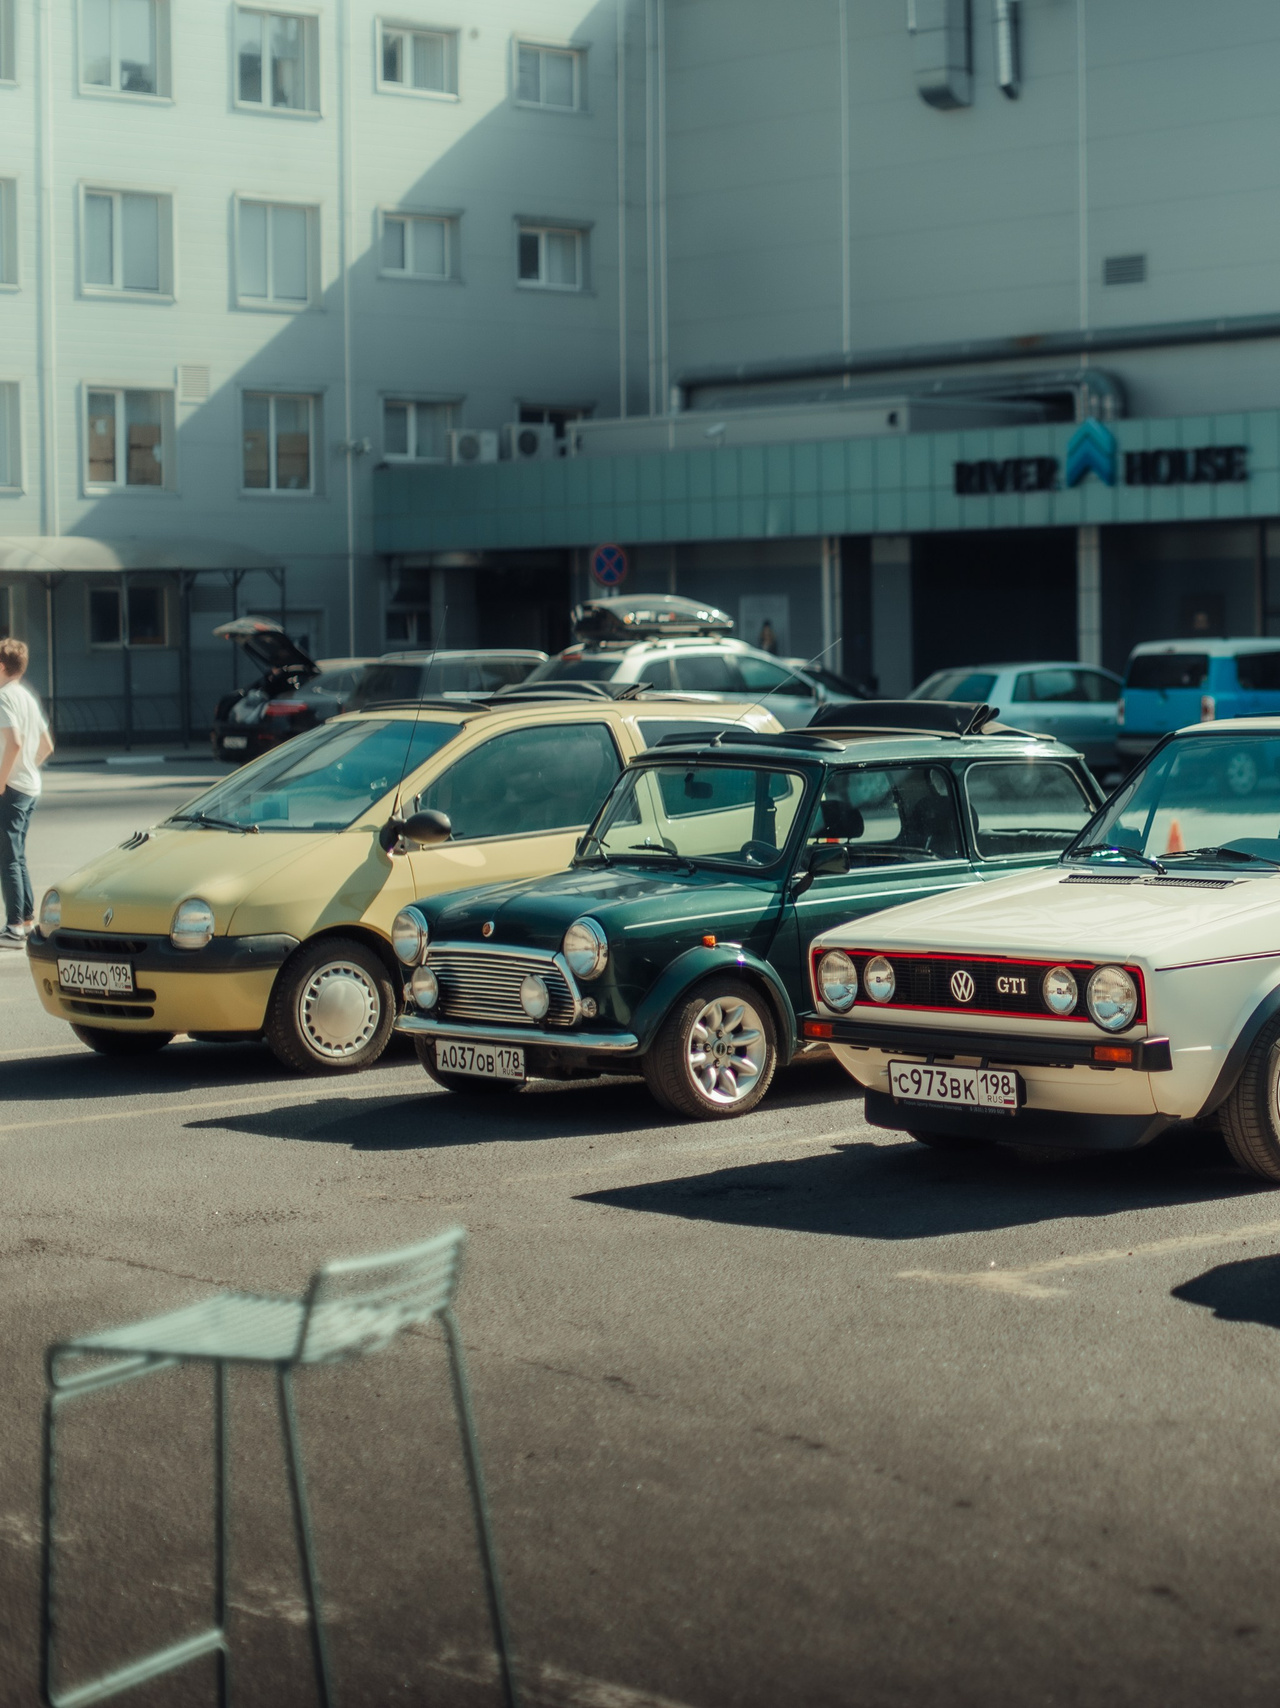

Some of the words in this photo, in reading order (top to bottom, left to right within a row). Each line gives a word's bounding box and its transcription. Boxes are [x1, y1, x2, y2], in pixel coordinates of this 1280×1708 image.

[954, 456, 1059, 495] RIVER
[1124, 445, 1249, 486] HOUSE
[109, 965, 128, 982] 199
[997, 976, 1026, 995] GTI
[497, 1050, 520, 1069] 178
[502, 1068, 515, 1076] RUS
[980, 1073, 1012, 1096] 198
[987, 1094, 1003, 1104] RUS
